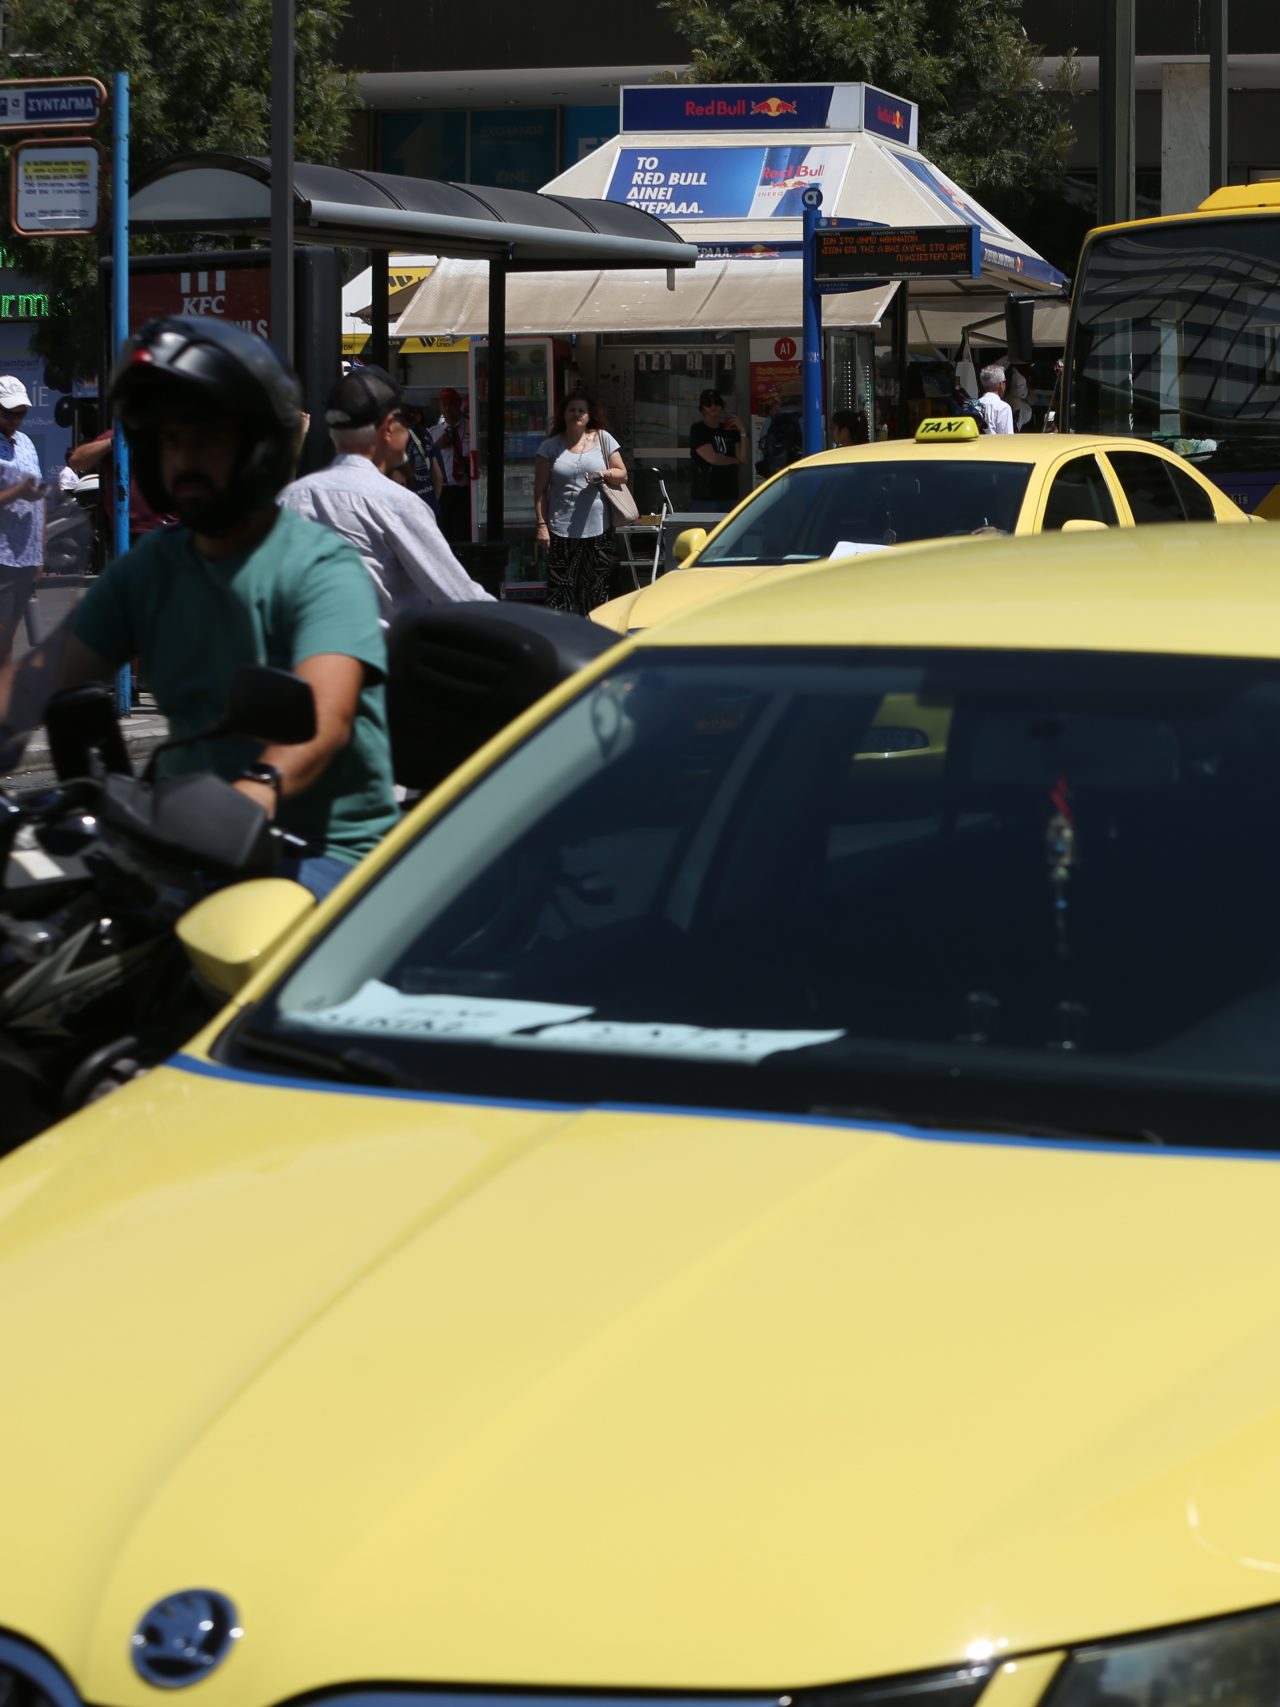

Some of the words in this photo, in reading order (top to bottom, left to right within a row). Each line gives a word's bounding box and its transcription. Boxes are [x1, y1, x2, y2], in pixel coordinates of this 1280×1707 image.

[28, 96, 94, 112] ΣΥΝΤΑΓΜΑ
[685, 99, 715, 116] Red
[717, 99, 746, 116] Bull
[637, 156, 659, 170] ΤΟ
[763, 164, 795, 179] Red
[796, 164, 825, 178] Bull
[631, 172, 665, 186] RED
[668, 172, 707, 186] BULL
[626, 186, 673, 200] ΔΙΝΕΙ
[182, 295, 226, 315] KFC
[780, 342, 791, 355] A1
[0, 358, 39, 368] owntown
[921, 421, 964, 433] TAXI
